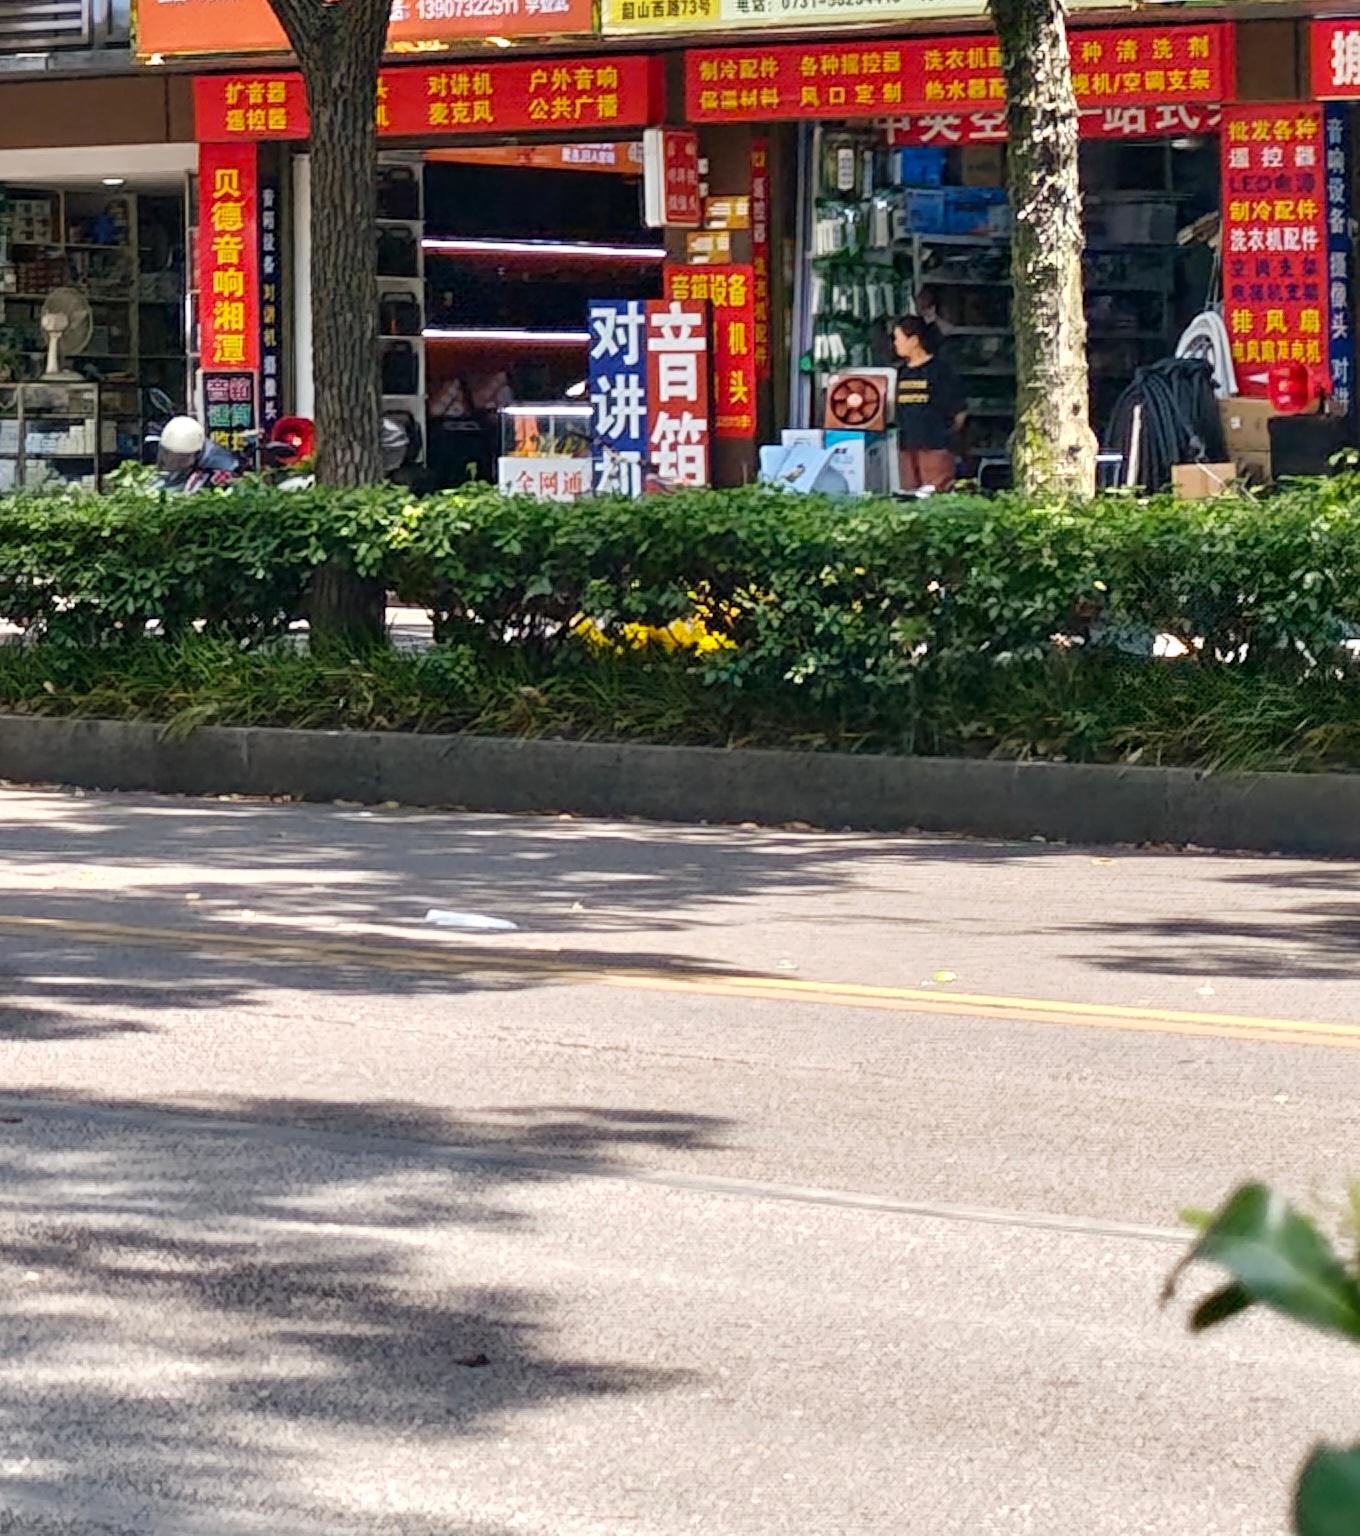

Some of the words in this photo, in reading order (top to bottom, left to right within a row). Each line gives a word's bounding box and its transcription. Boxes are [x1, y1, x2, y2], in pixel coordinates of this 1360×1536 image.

[427, 72, 494, 99] 对讲机
[529, 67, 618, 93] 户外音响
[427, 100, 494, 126] 麦克风
[528, 94, 618, 121] 公共广播
[1228, 119, 1318, 142] 批发各种
[1229, 199, 1319, 222] 制冷配件
[1230, 226, 1319, 252] 洗衣机配件
[211, 168, 246, 364] 贝德音响湘潭
[1232, 309, 1321, 334] 排风扇
[590, 304, 646, 497] 对讲机
[647, 301, 708, 488] 音箱
